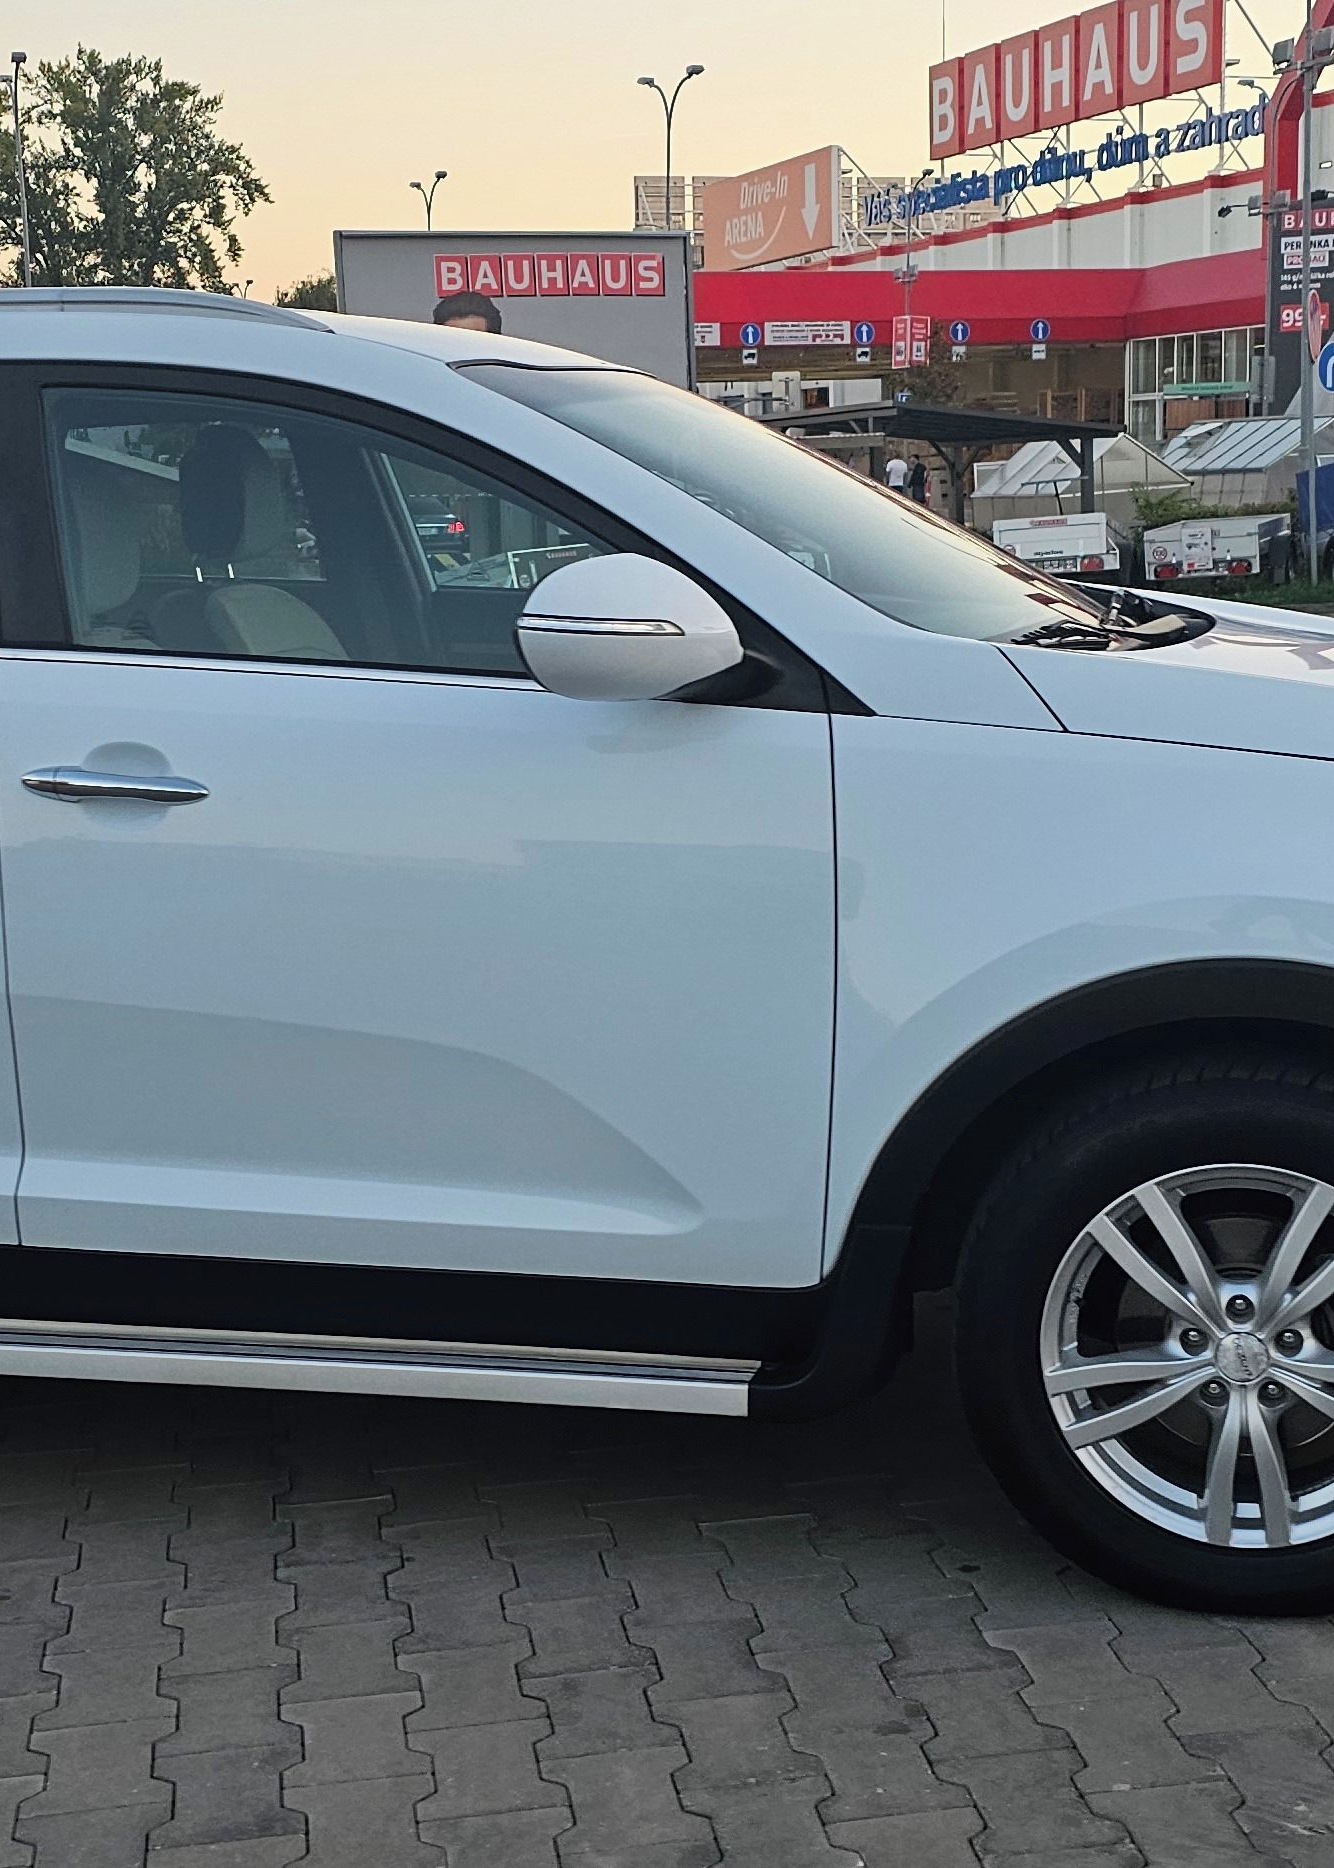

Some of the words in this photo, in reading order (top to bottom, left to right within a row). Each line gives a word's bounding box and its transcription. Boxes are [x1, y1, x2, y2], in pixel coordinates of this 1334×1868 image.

[932, 0, 1207, 145] BAUHAUS
[994, 164, 1028, 206] pro
[1155, 128, 1170, 159] a
[1177, 93, 1269, 152] zahrad
[740, 171, 788, 209] Drive-In
[724, 211, 764, 247] ARENA
[1284, 239, 1329, 251] PERNKA
[440, 259, 660, 292] BAUHAUS
